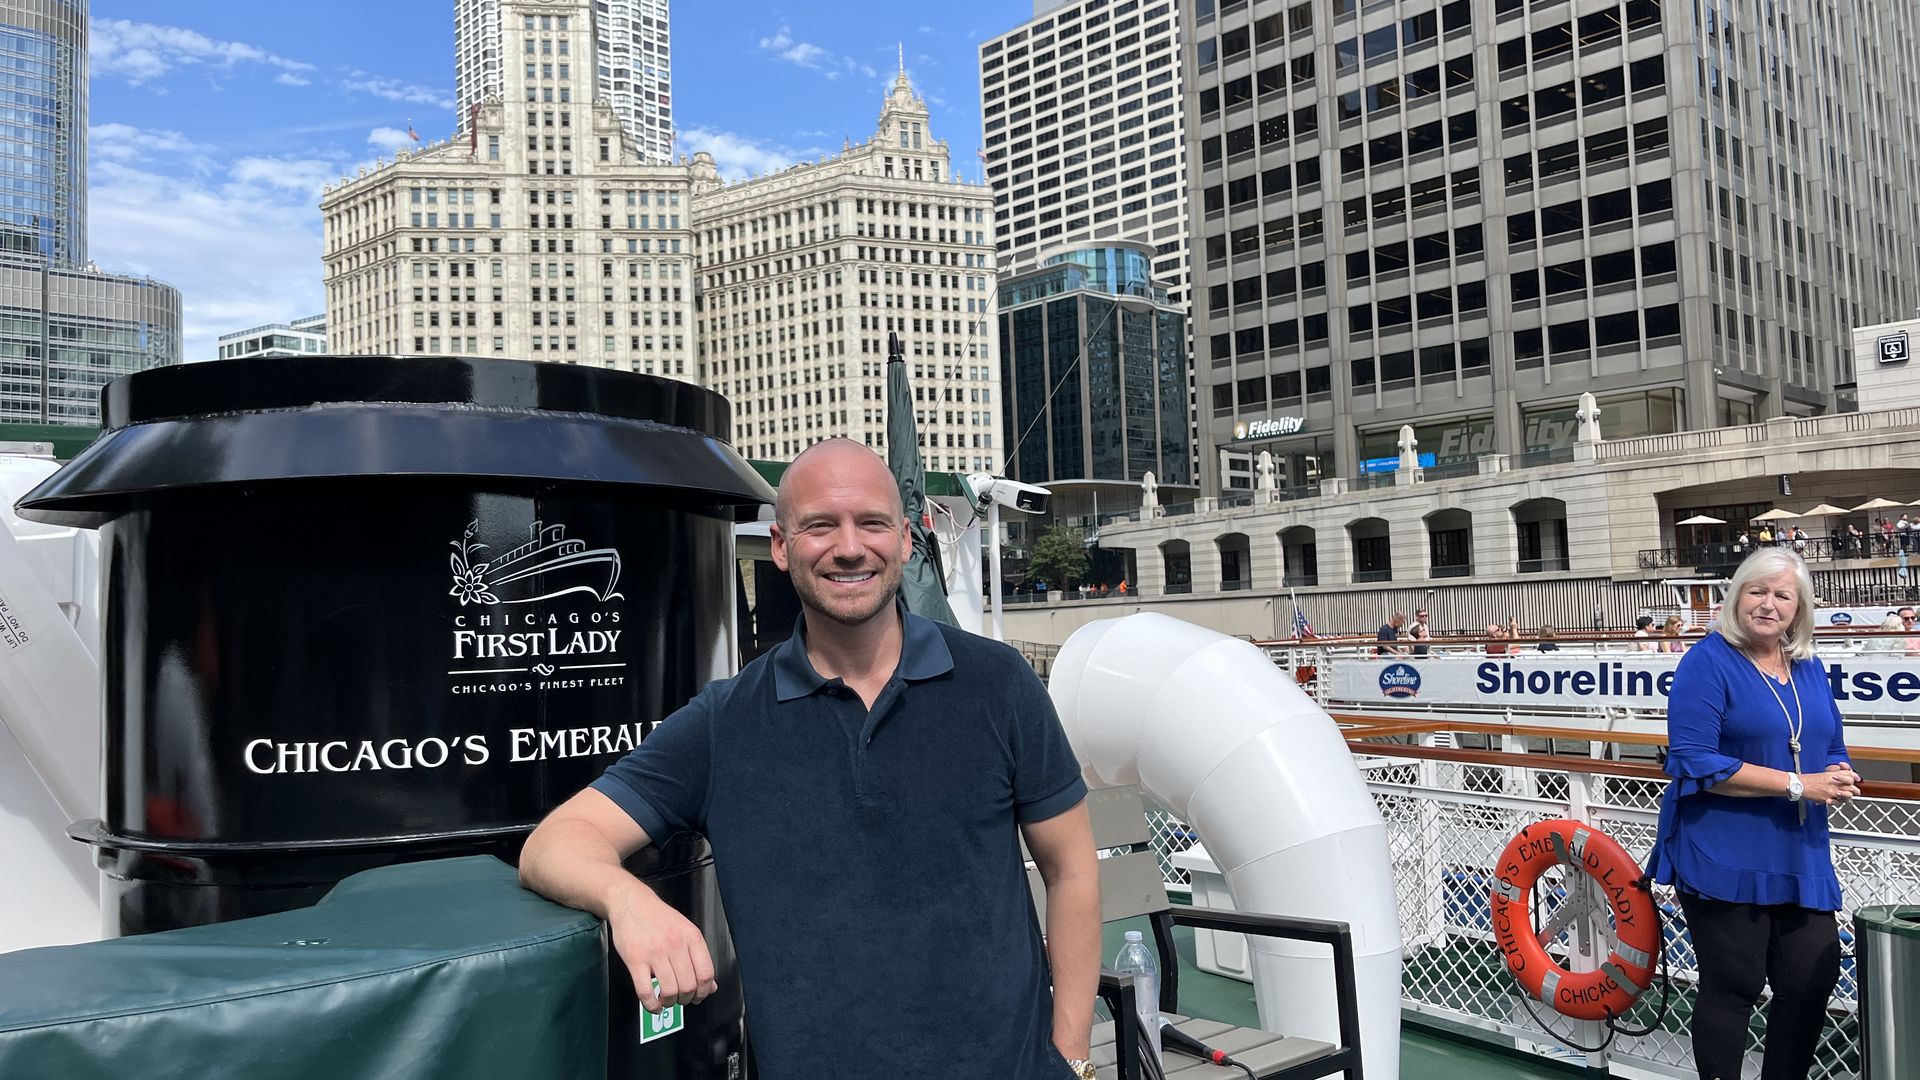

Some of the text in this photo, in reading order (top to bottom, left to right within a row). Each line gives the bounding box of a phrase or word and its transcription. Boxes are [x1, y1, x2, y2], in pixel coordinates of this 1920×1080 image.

[1248, 416, 1304, 435] Fidelity
[6, 615, 21, 630] NOT
[454, 611, 621, 627] CHICAGO'S
[18, 631, 29, 643] DO
[452, 627, 622, 659] FIRST LADY
[452, 677, 625, 694] CHICAGO'S FINEST FLEET
[1382, 672, 1418, 685] Shoreline
[1476, 662, 1674, 696] Shoreline
[243, 720, 663, 775] CHICAGO'S EMERAL
[1497, 837, 1636, 972] CHICAGO'S EMEALD LADY
